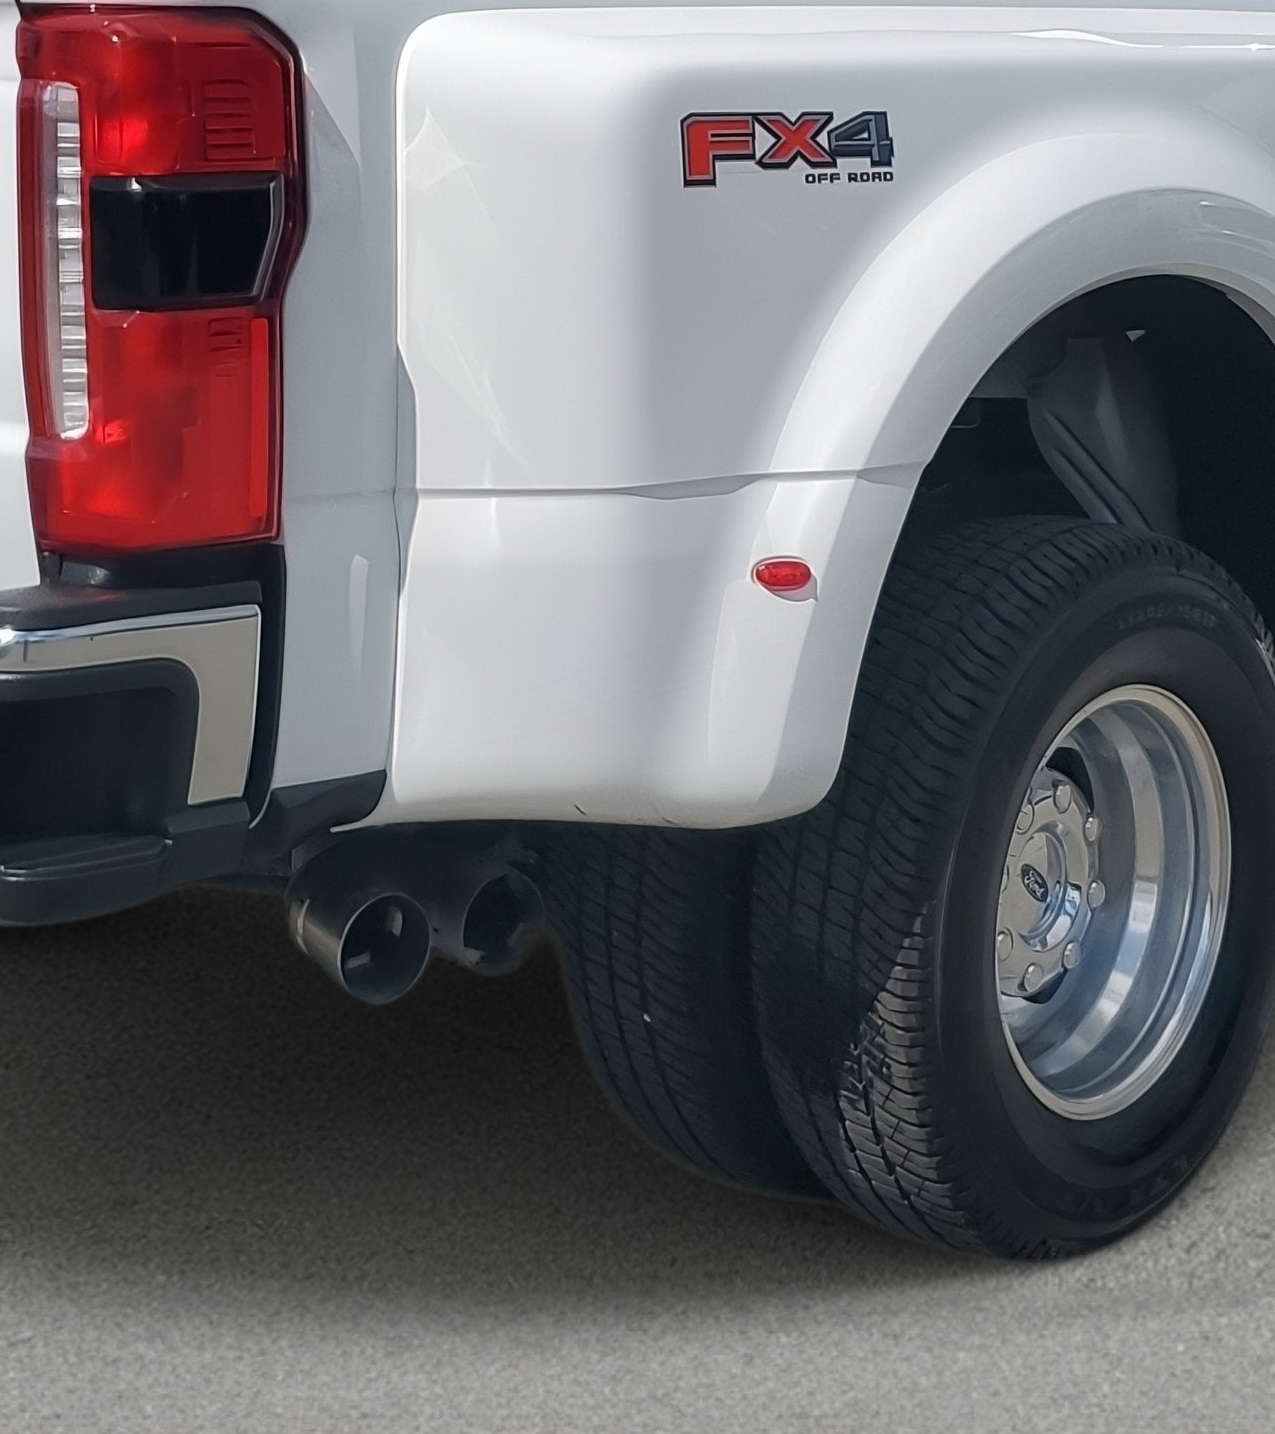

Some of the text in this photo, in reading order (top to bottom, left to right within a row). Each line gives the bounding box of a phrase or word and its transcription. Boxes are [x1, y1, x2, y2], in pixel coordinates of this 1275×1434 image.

[680, 111, 894, 188] FX4
[804, 171, 894, 184] OFF ROAD
